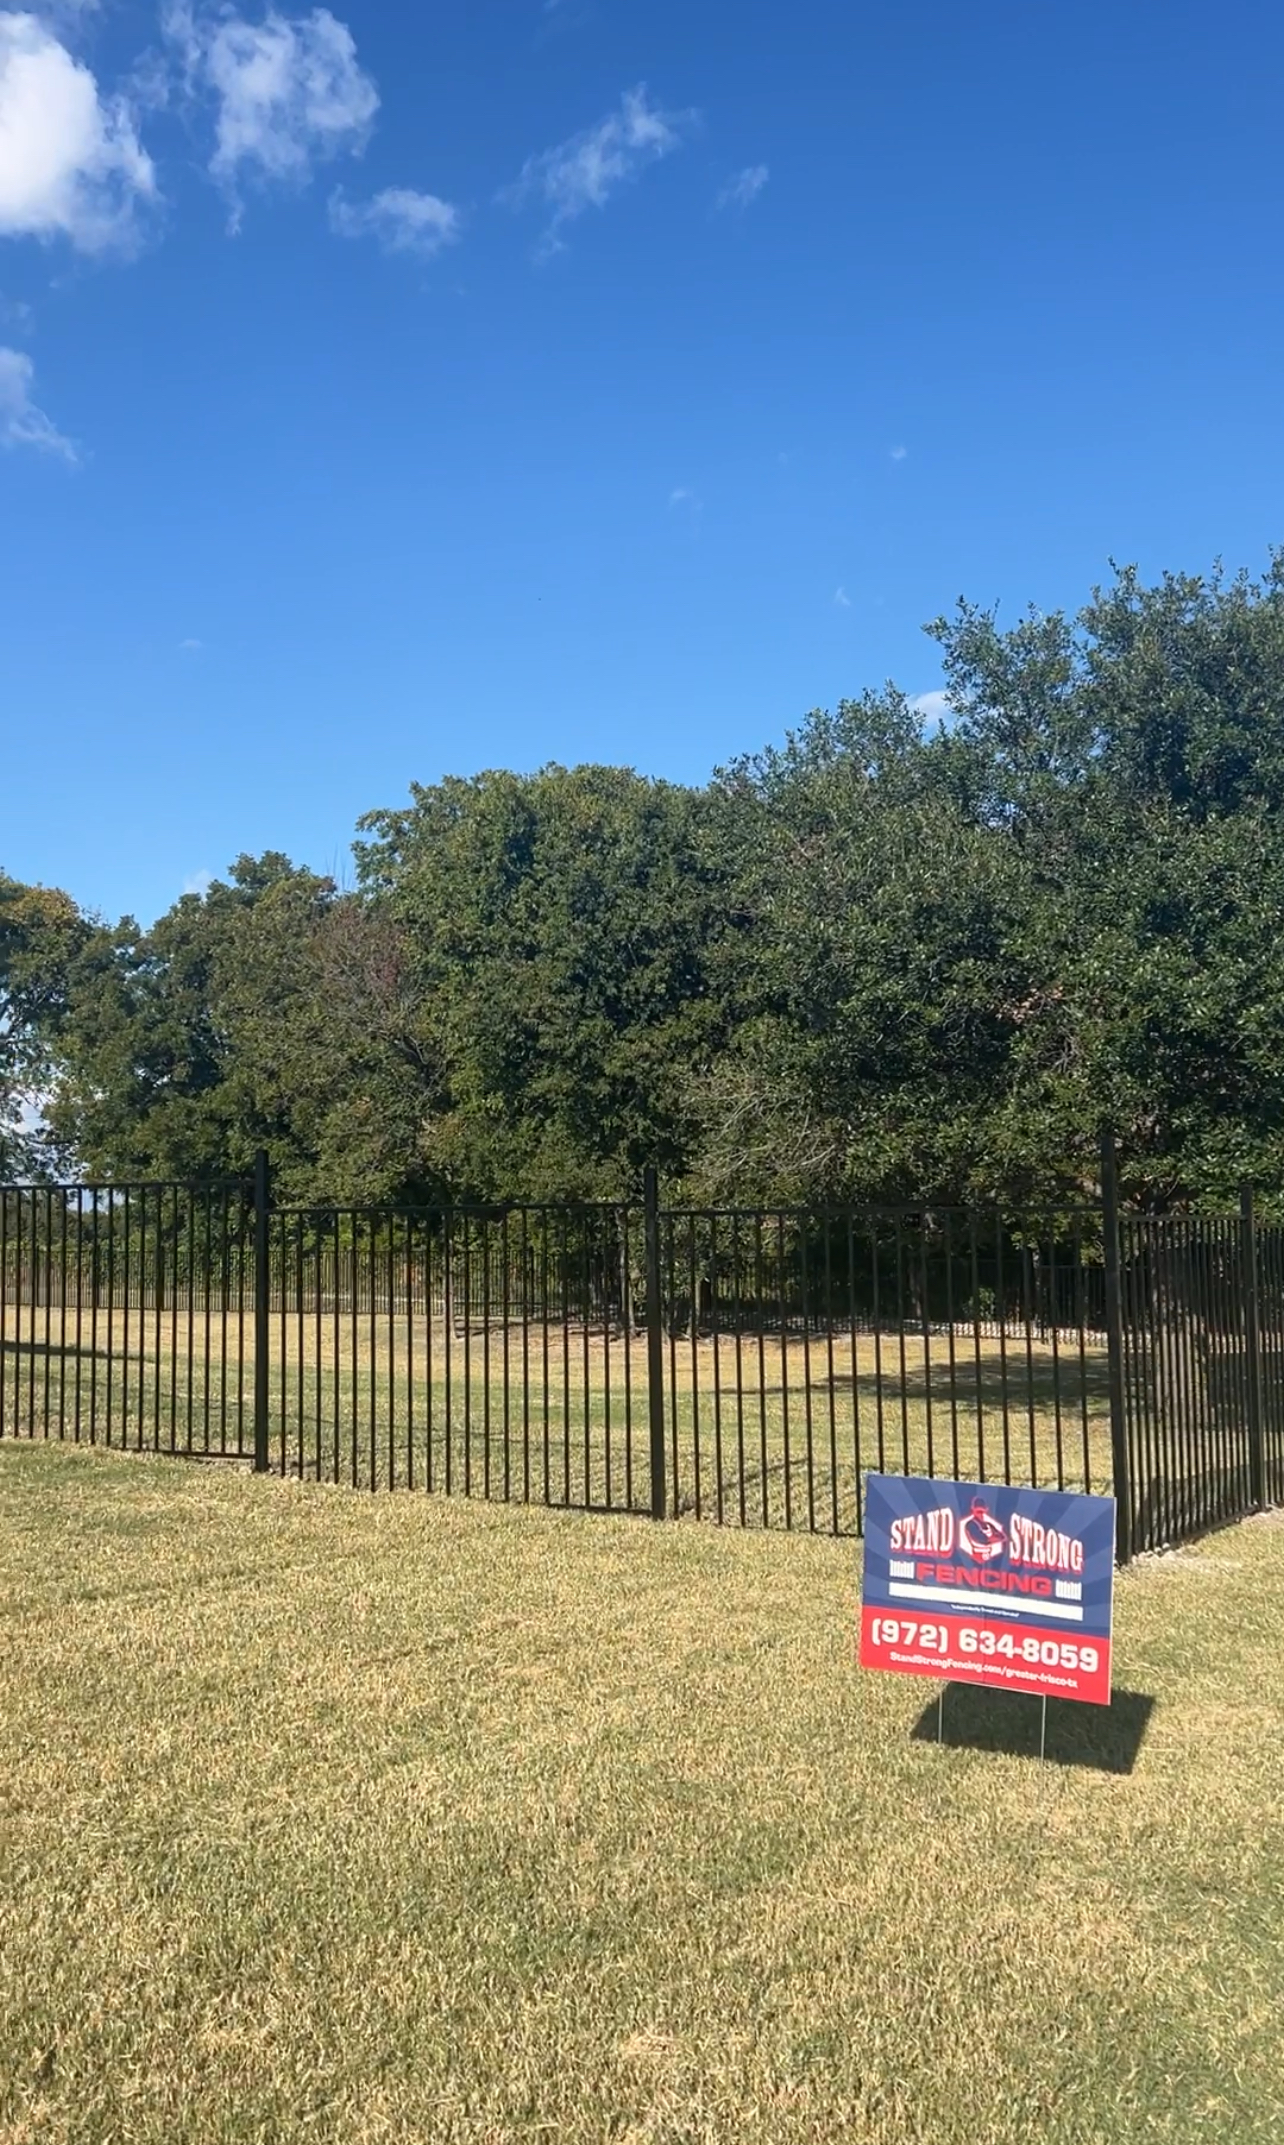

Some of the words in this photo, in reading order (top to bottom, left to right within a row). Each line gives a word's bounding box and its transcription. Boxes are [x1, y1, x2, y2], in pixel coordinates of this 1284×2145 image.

[890, 1507, 953, 1553] STAND
[1009, 1513, 1083, 1572] STRONG
[916, 1563, 1052, 1595] FENCING
[872, 1618, 948, 1653] (972)
[959, 1628, 1099, 1673] 634-8059
[889, 1652, 1078, 1688] StandStrongFencing.com/greater-frisco-tx
